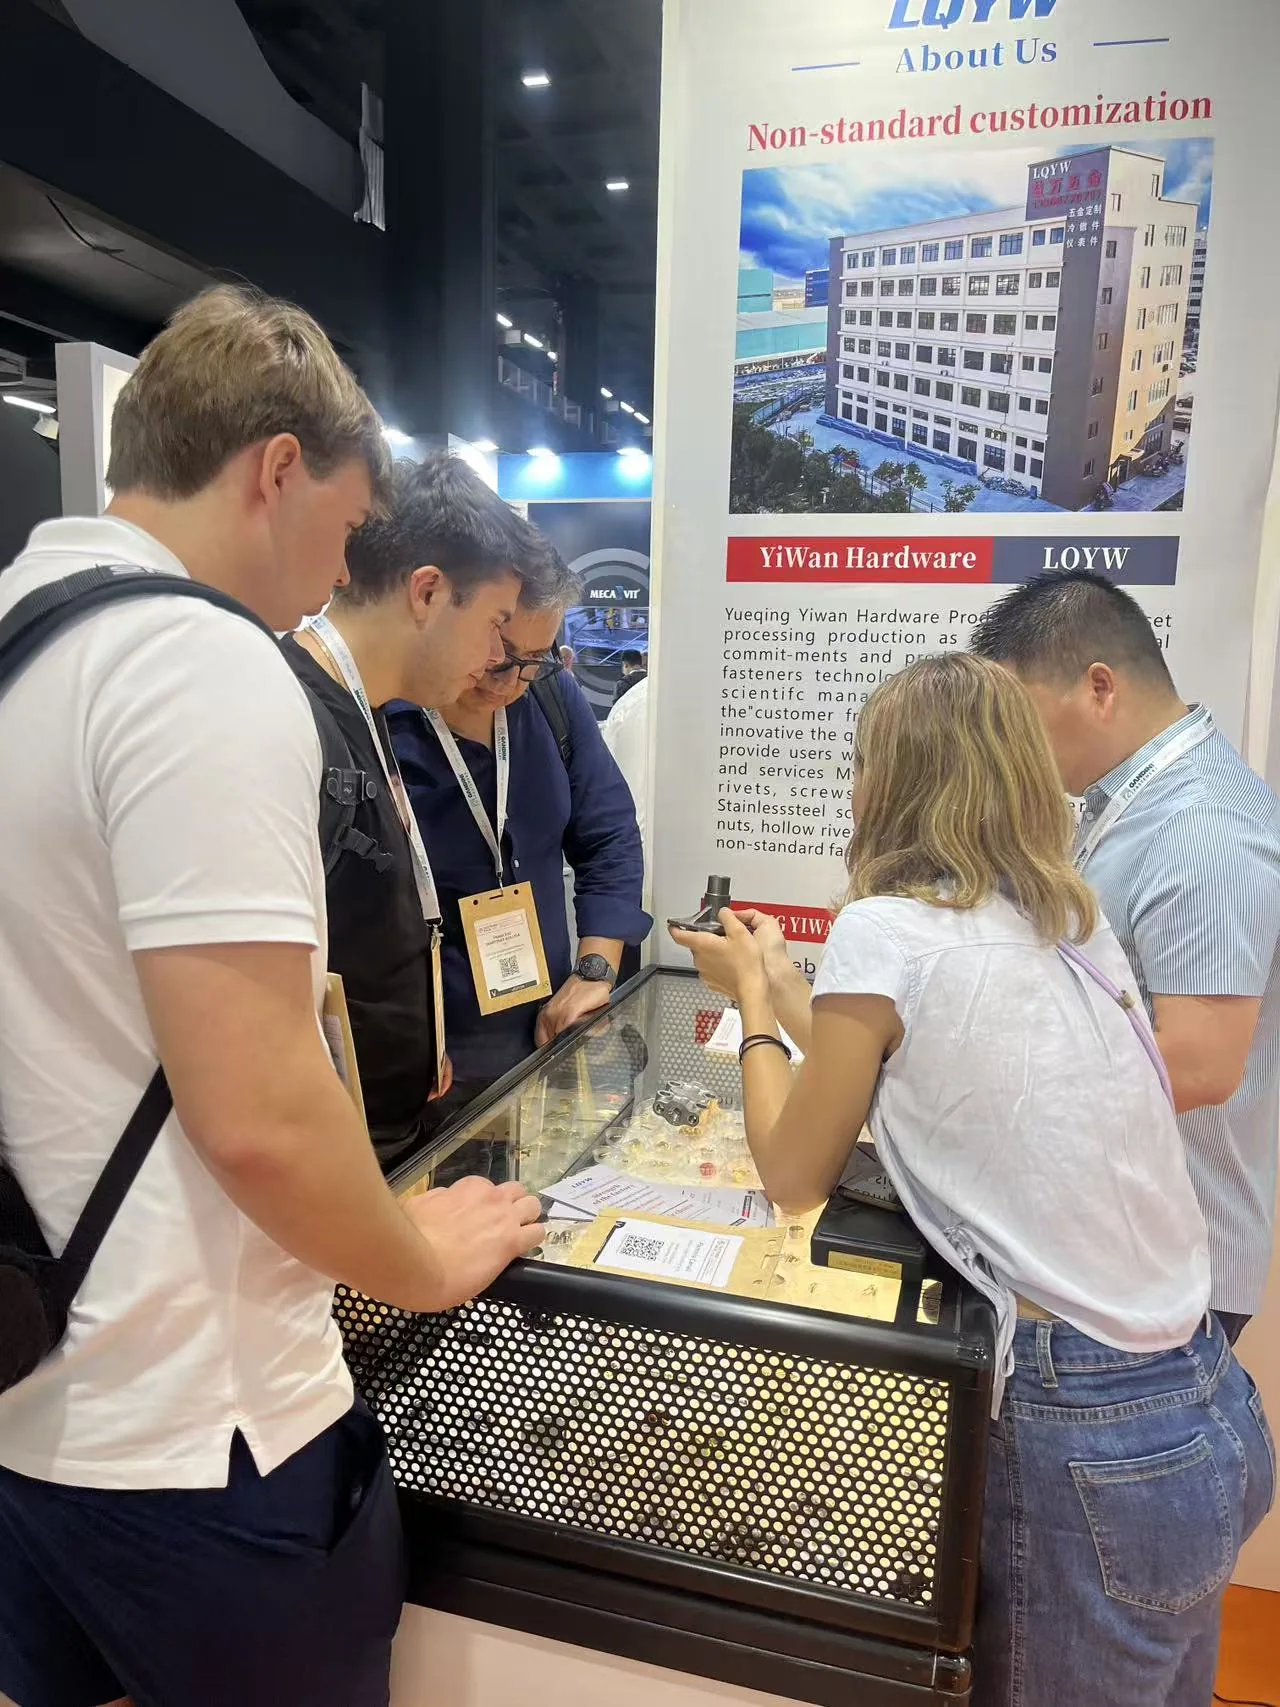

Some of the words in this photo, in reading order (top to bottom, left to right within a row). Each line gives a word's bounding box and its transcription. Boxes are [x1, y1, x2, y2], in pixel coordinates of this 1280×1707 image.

[895, 42, 1005, 74] About
[1014, 37, 1058, 65] Us
[746, 104, 963, 152] Non-standard
[969, 90, 1213, 136] customization
[1032, 160, 1073, 180] LQYW
[759, 545, 839, 569] YiWan
[845, 545, 977, 570] Hardware
[725, 607, 790, 626] Yueqing
[798, 608, 848, 624] Yiwan
[856, 609, 940, 625] Hardware
[723, 628, 816, 646] processing
[827, 629, 927, 647] production
[938, 632, 958, 645] as
[722, 648, 848, 663] commit-ments
[859, 650, 893, 664] and
[722, 665, 802, 682] fasteners
[721, 685, 805, 701] scientifc
[719, 723, 804, 740] innovative
[810, 726, 838, 742] the
[719, 743, 782, 760] provide
[789, 749, 833, 761] users
[718, 761, 748, 776] and
[758, 764, 825, 780] services
[1128, 763, 1155, 789] GANDINI
[459, 773, 473, 799] GANDINI
[717, 780, 778, 798] rivets,
[717, 798, 827, 818] Stainlesssteel
[716, 818, 755, 834] nuts,
[760, 819, 816, 837] hollow
[821, 823, 855, 839] rive
[715, 837, 825, 857] non-standard
